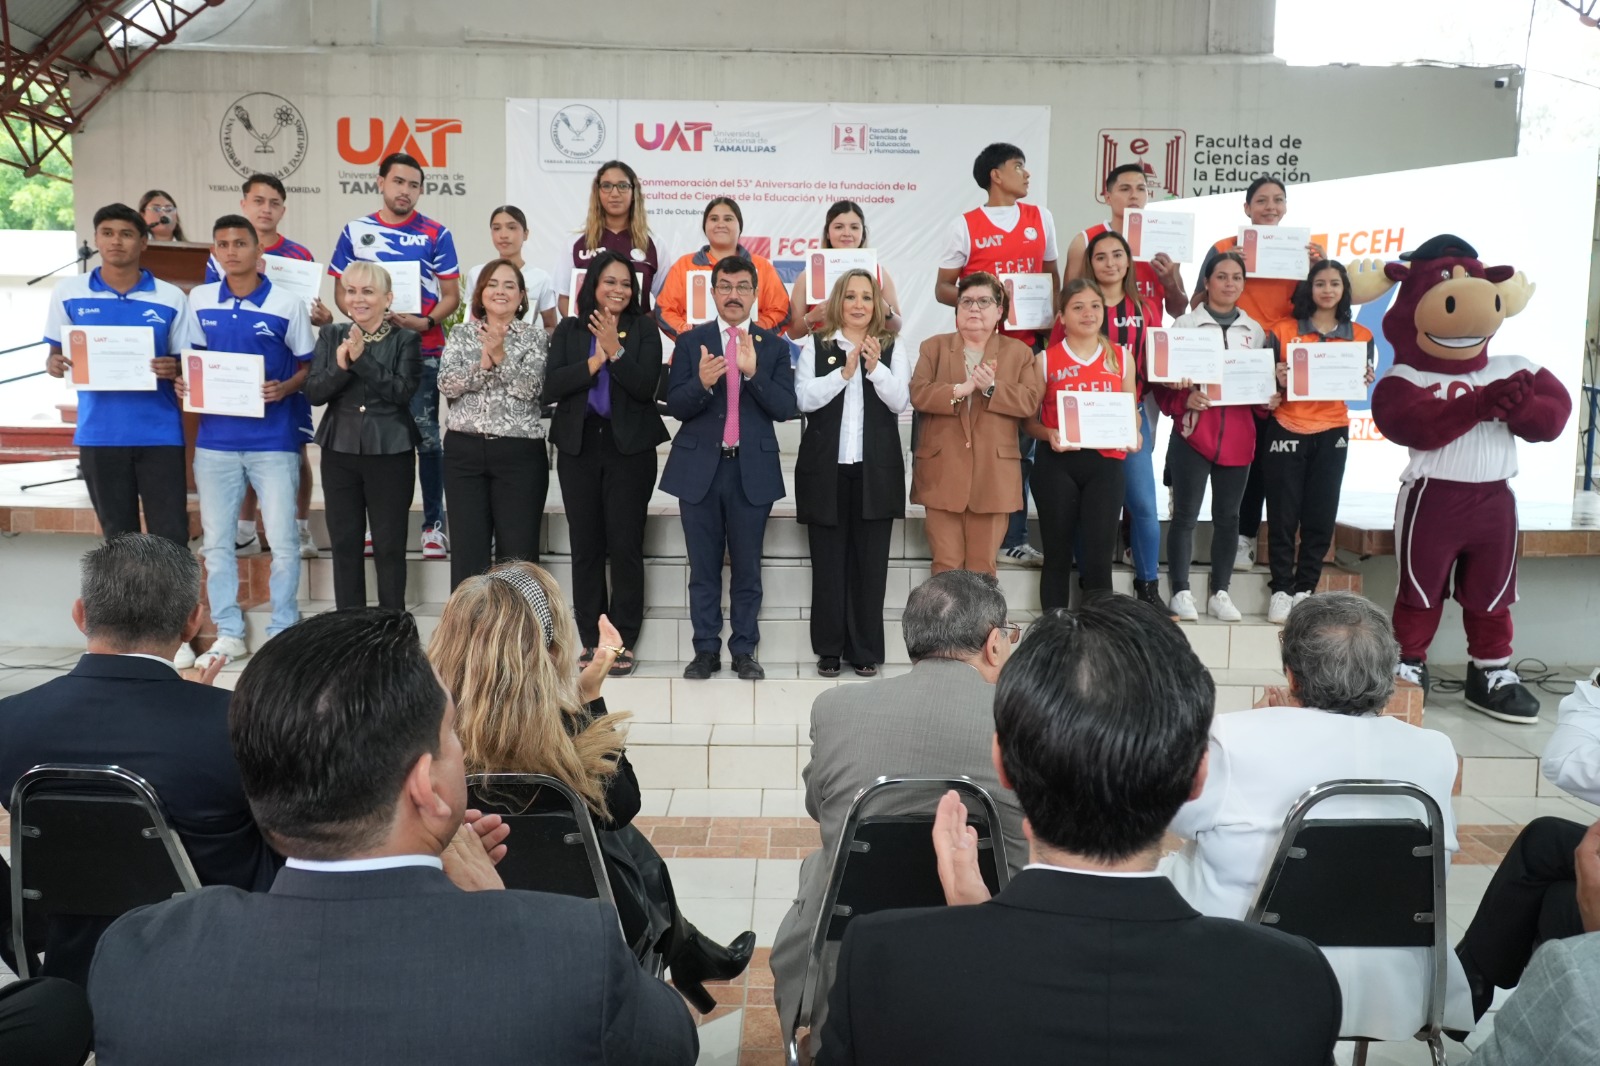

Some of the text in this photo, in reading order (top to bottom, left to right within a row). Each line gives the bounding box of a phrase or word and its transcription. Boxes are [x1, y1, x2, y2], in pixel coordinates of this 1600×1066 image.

[337, 115, 463, 168] UAT
[635, 120, 713, 152] UAT
[1195, 134, 1303, 149] Facultad de
[713, 144, 777, 153] TAMAULIPAS
[876, 140, 911, 148] Educación
[1193, 150, 1299, 166] Ciencias de
[338, 170, 380, 179] Universi
[453, 172, 464, 181] de
[1193, 167, 1311, 182] la Educación
[285, 185, 321, 194] ROBIDAD
[339, 181, 466, 196] TAMPAS
[720, 179, 735, 188] del
[754, 179, 813, 190] Aniversario
[814, 180, 827, 190] de
[828, 180, 838, 190] la
[840, 180, 891, 191] fundación
[893, 181, 906, 191] de
[907, 182, 917, 191] la
[680, 191, 693, 201] de
[694, 191, 737, 201] Ciencias
[738, 192, 751, 202] de
[753, 192, 762, 202] la
[764, 193, 816, 203] Educación
[817, 195, 823, 204] y
[825, 194, 895, 204] Humanidades
[399, 233, 430, 247] UAT
[777, 237, 820, 256] FCE
[974, 234, 1004, 249] UAT
[1336, 227, 1405, 257] FCEH
[994, 258, 1035, 276] FCEH
[1113, 315, 1143, 328] UAT
[1050, 364, 1082, 383] UAT
[1269, 440, 1300, 453] AKT
